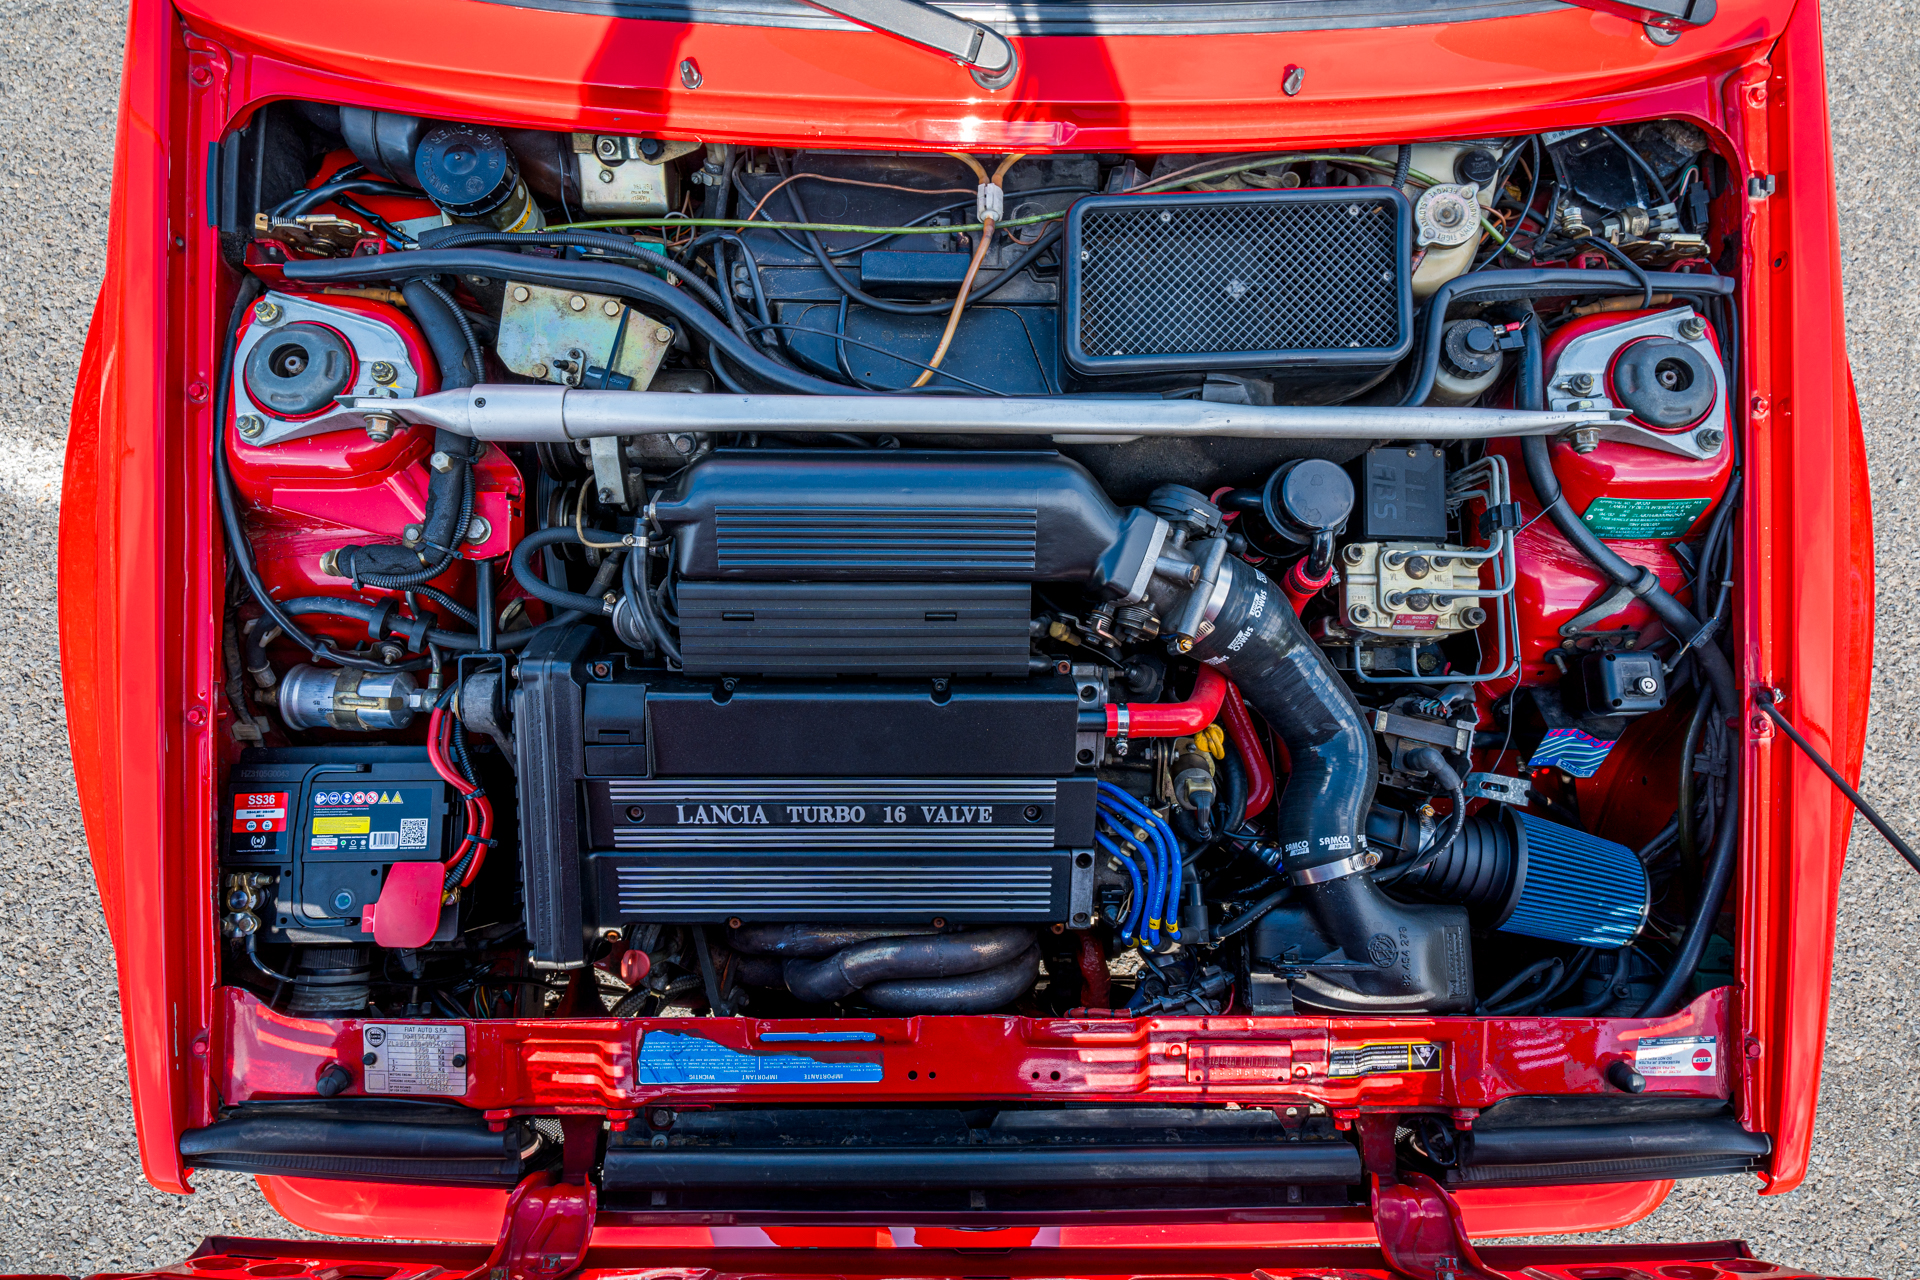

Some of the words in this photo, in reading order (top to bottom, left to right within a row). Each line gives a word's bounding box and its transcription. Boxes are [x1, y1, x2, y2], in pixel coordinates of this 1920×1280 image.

[431, 124, 473, 144] POWER
[422, 146, 450, 196] STEERING
[1428, 186, 1458, 198] REMOVE
[1467, 200, 1478, 218] TURN
[1372, 462, 1397, 520] ABS
[1254, 589, 1268, 618] SAMCO
[1232, 626, 1254, 652] SAMCO
[248, 795, 275, 805] SS36
[676, 804, 770, 824] LANCIA
[786, 806, 866, 824] TURBO
[882, 806, 907, 823] 16
[920, 806, 993, 824] VALVE
[1285, 840, 1309, 852] SAMCO
[1319, 835, 1350, 846] SAMCO
